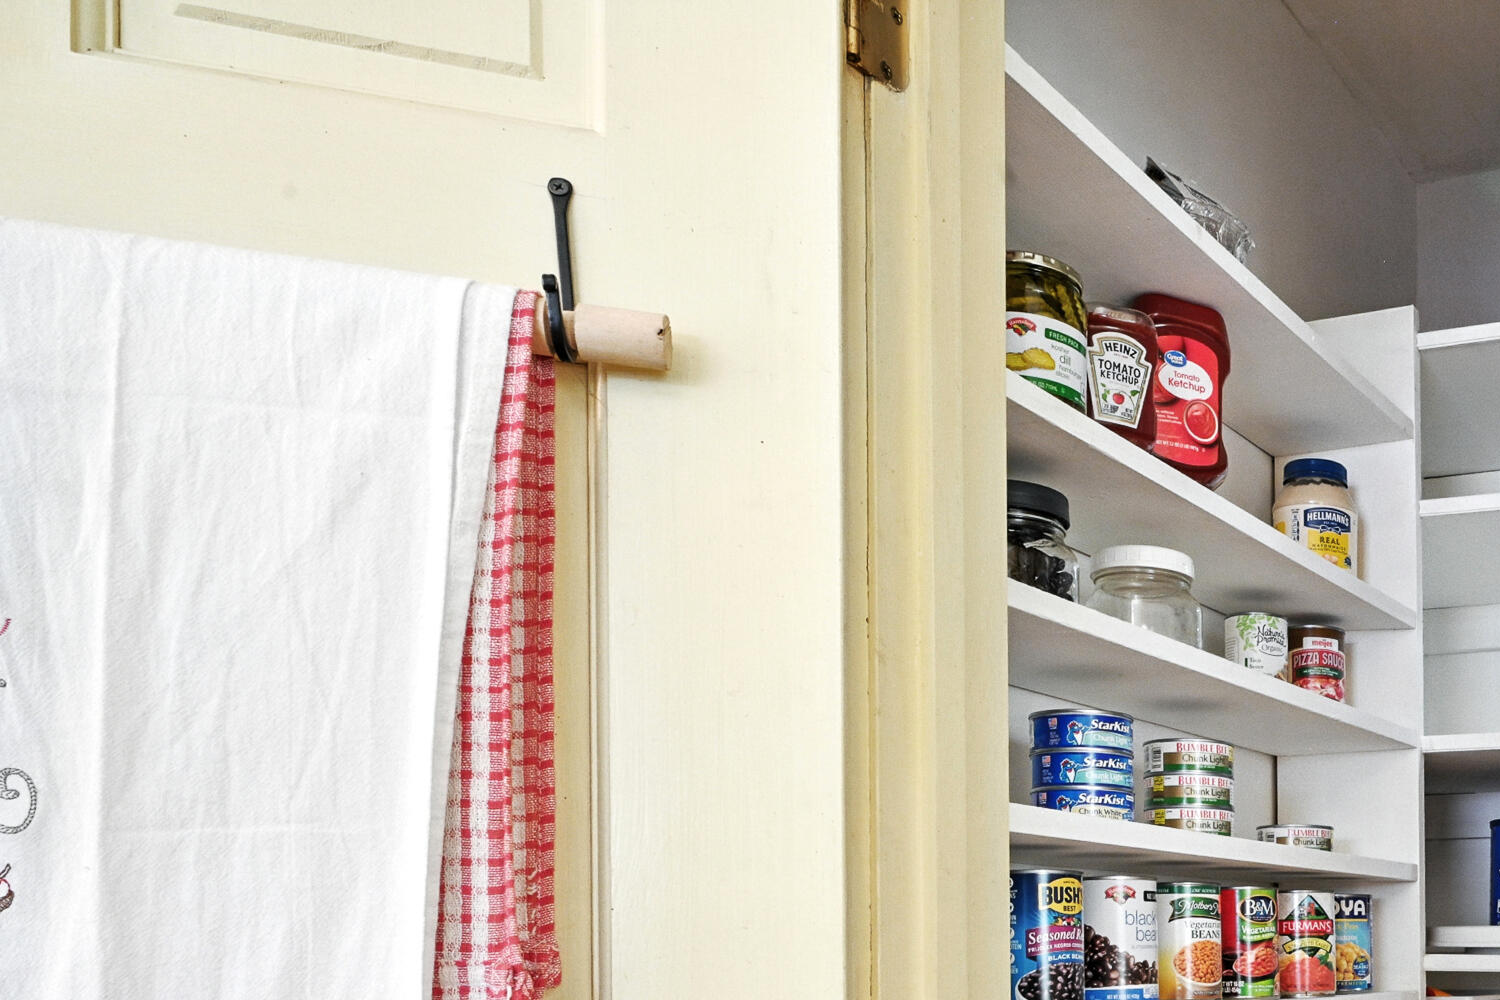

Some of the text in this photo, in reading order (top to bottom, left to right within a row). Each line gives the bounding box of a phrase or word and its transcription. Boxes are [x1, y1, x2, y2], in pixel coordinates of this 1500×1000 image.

[1104, 342, 1137, 359] HEINZ
[1098, 358, 1141, 378] TOMATO
[1174, 370, 1200, 382] Tomato
[1100, 369, 1139, 386] KETCHUP
[1168, 377, 1206, 394] Ketchup
[1320, 536, 1340, 546] REAL
[1293, 652, 1319, 668] PIZZA
[1090, 719, 1130, 734] StarKist
[1083, 757, 1127, 770] StarKist
[1078, 792, 1125, 805] StarKist
[1244, 899, 1274, 916] B&M
[1335, 900, 1366, 917] YA
[1028, 929, 1076, 946] Seasoned
